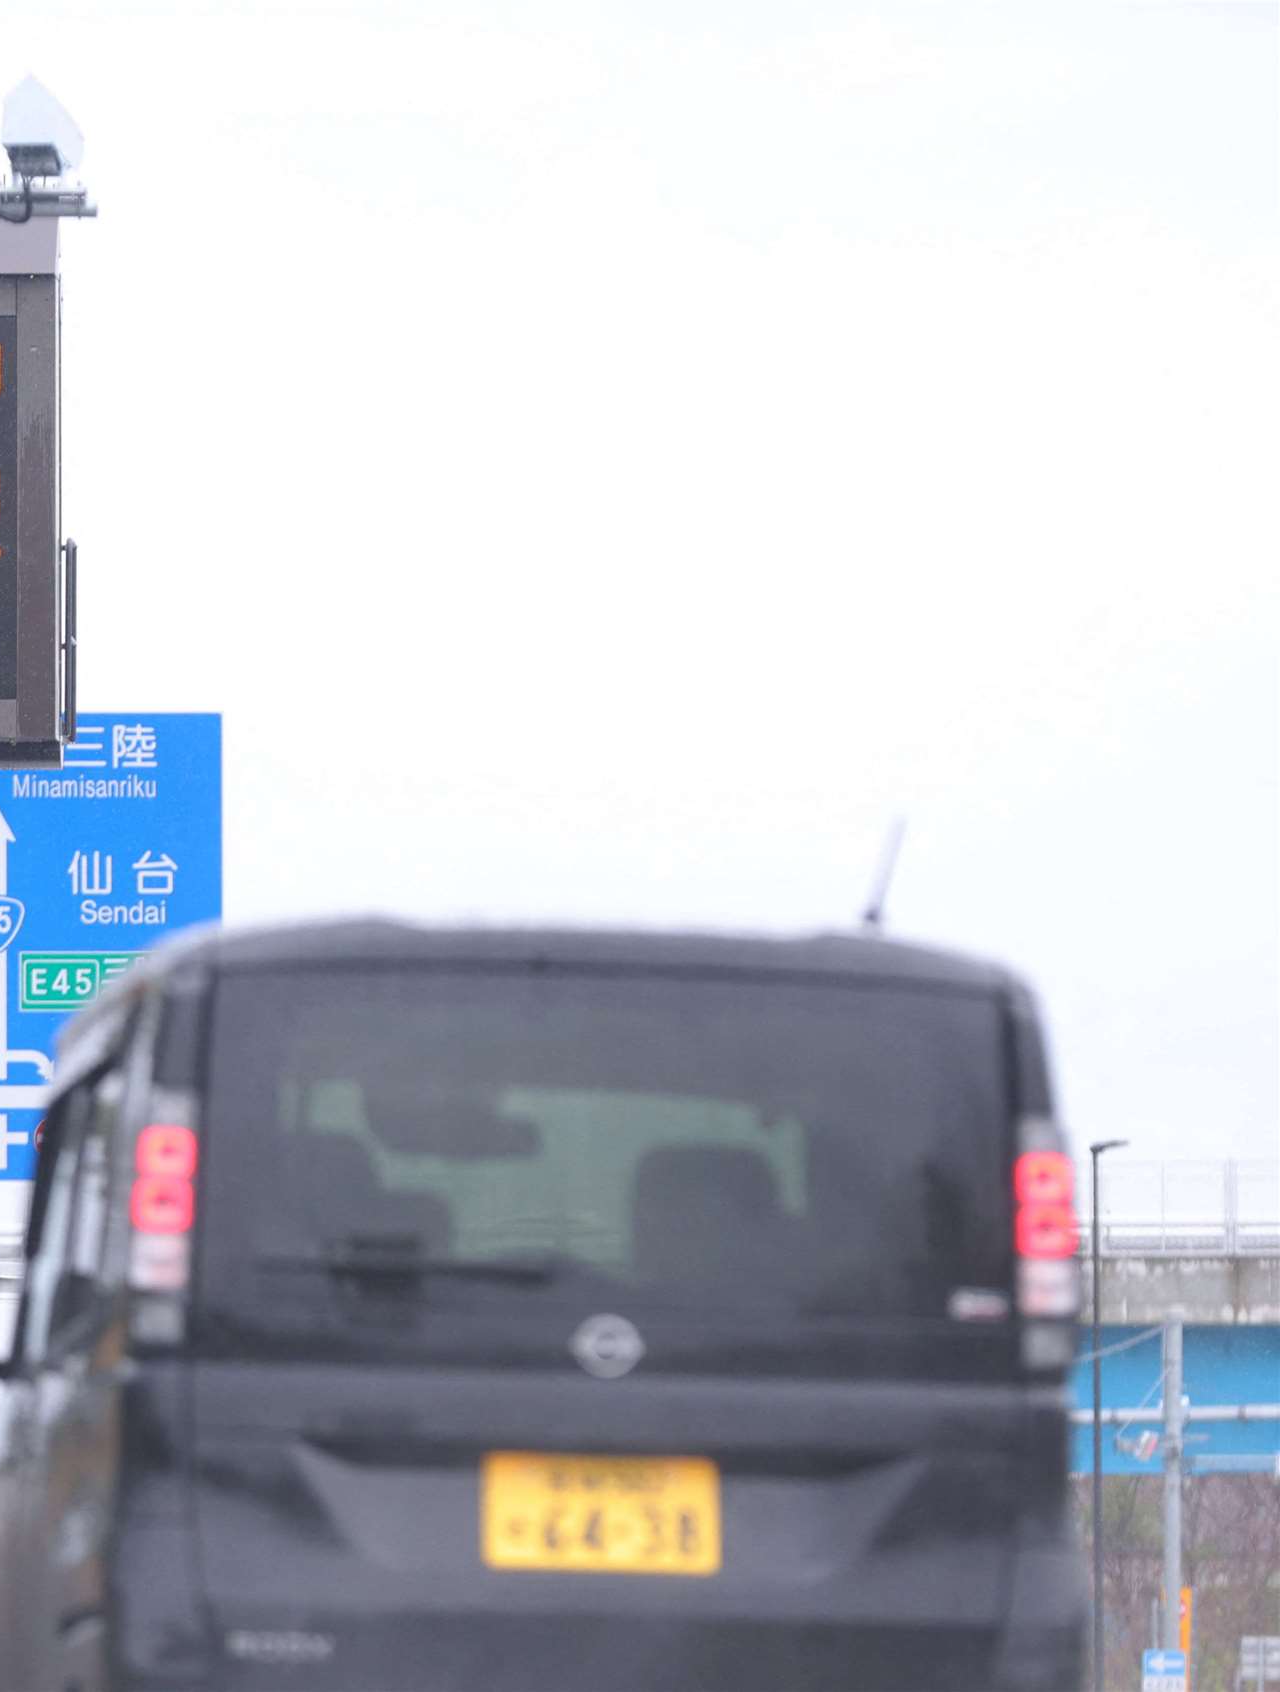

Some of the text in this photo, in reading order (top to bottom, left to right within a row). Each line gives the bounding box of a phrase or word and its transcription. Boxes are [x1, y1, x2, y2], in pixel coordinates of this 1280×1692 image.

[13, 774, 158, 799] Minamisanriku
[68, 850, 179, 896] 仙台
[80, 900, 167, 925] Sendai
[31, 968, 93, 996] E45
